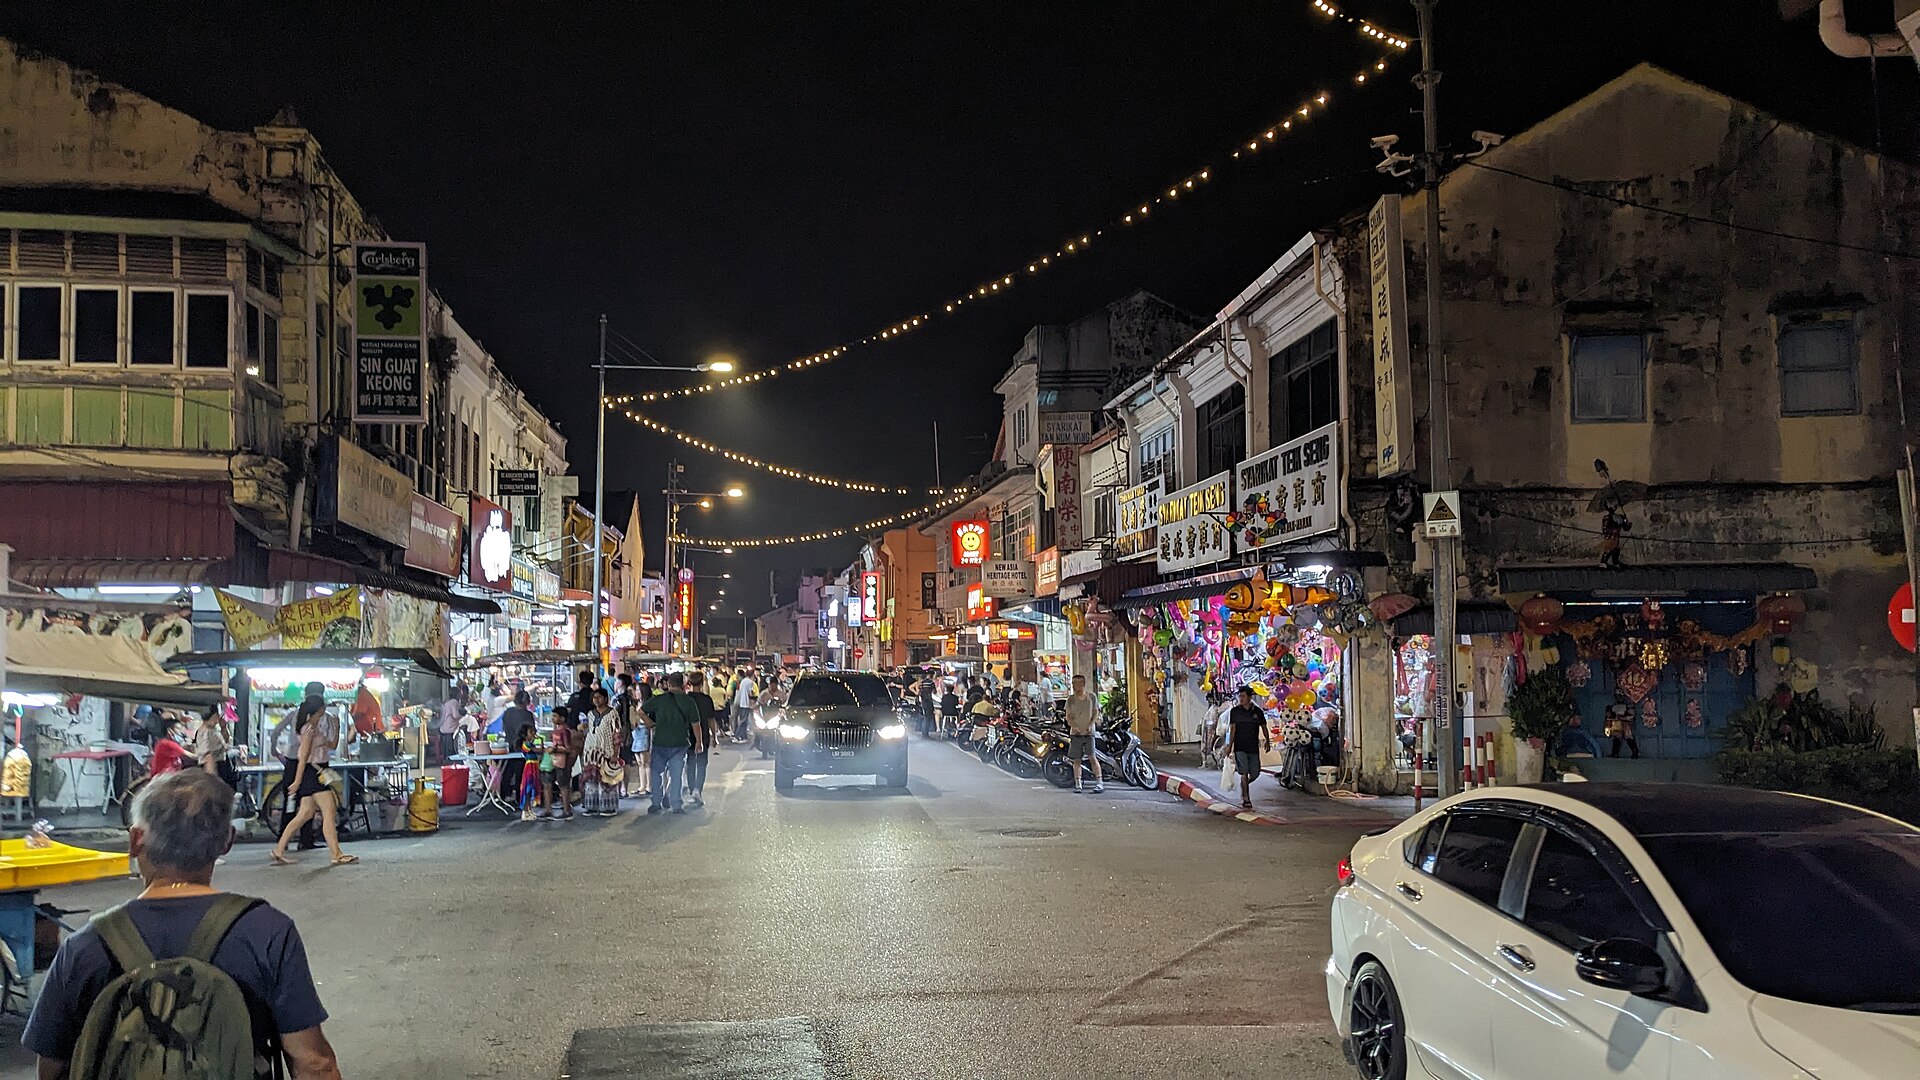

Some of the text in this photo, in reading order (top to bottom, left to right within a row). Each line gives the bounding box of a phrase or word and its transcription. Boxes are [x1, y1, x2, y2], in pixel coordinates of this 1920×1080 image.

[361, 250, 415, 268] Carlsberg
[360, 357, 417, 374] SIN GUAT
[366, 375, 412, 391] KEONG
[1046, 421, 1082, 432] SYARIKAT
[1041, 433, 1054, 443] TAN
[1241, 434, 1329, 491] SYARIKAT TEIK SENG
[1158, 496, 1188, 527] SYARIKAT
[1189, 490, 1206, 517] TEIK
[1206, 481, 1226, 511] SENG
[956, 523, 985, 537] HAPPY
[309, 620, 325, 632] TEH
